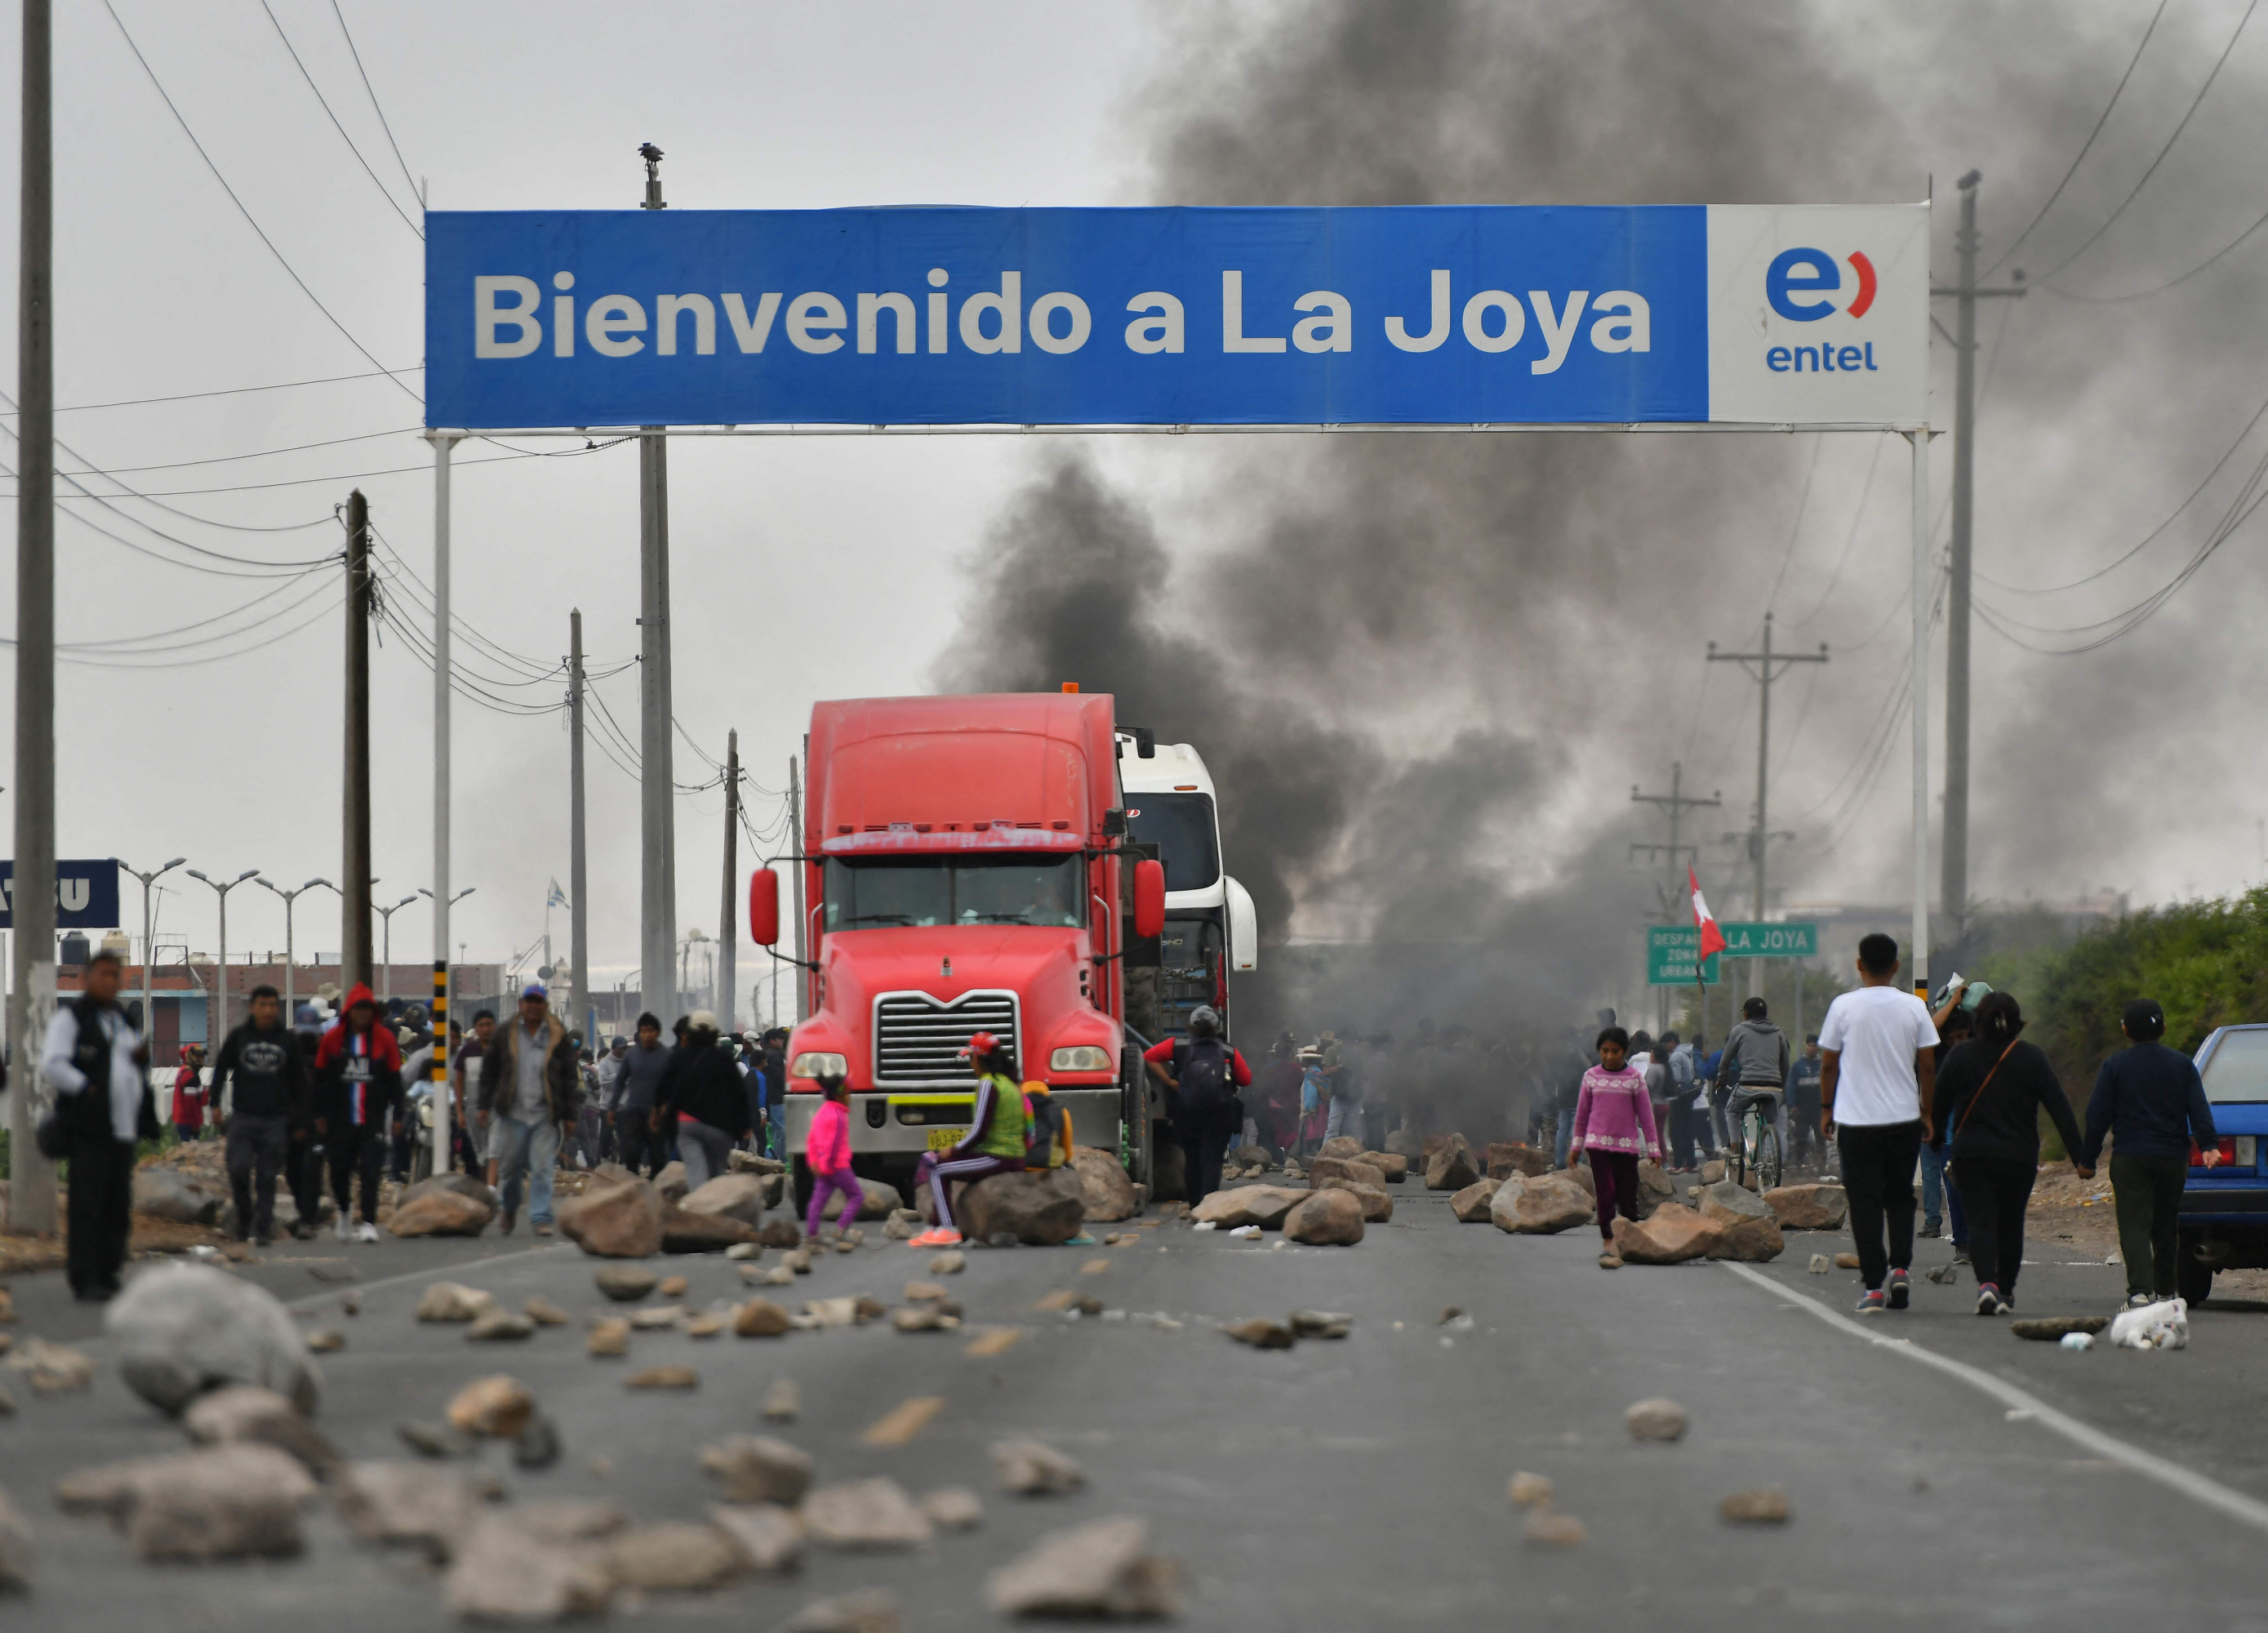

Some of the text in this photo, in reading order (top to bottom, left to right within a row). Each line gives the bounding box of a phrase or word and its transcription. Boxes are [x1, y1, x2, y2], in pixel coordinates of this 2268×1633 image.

[474, 267, 1651, 375] Bienvenido a La Joya
[1767, 341, 1878, 372] entel
[1728, 930, 1808, 949] LA JOYA
